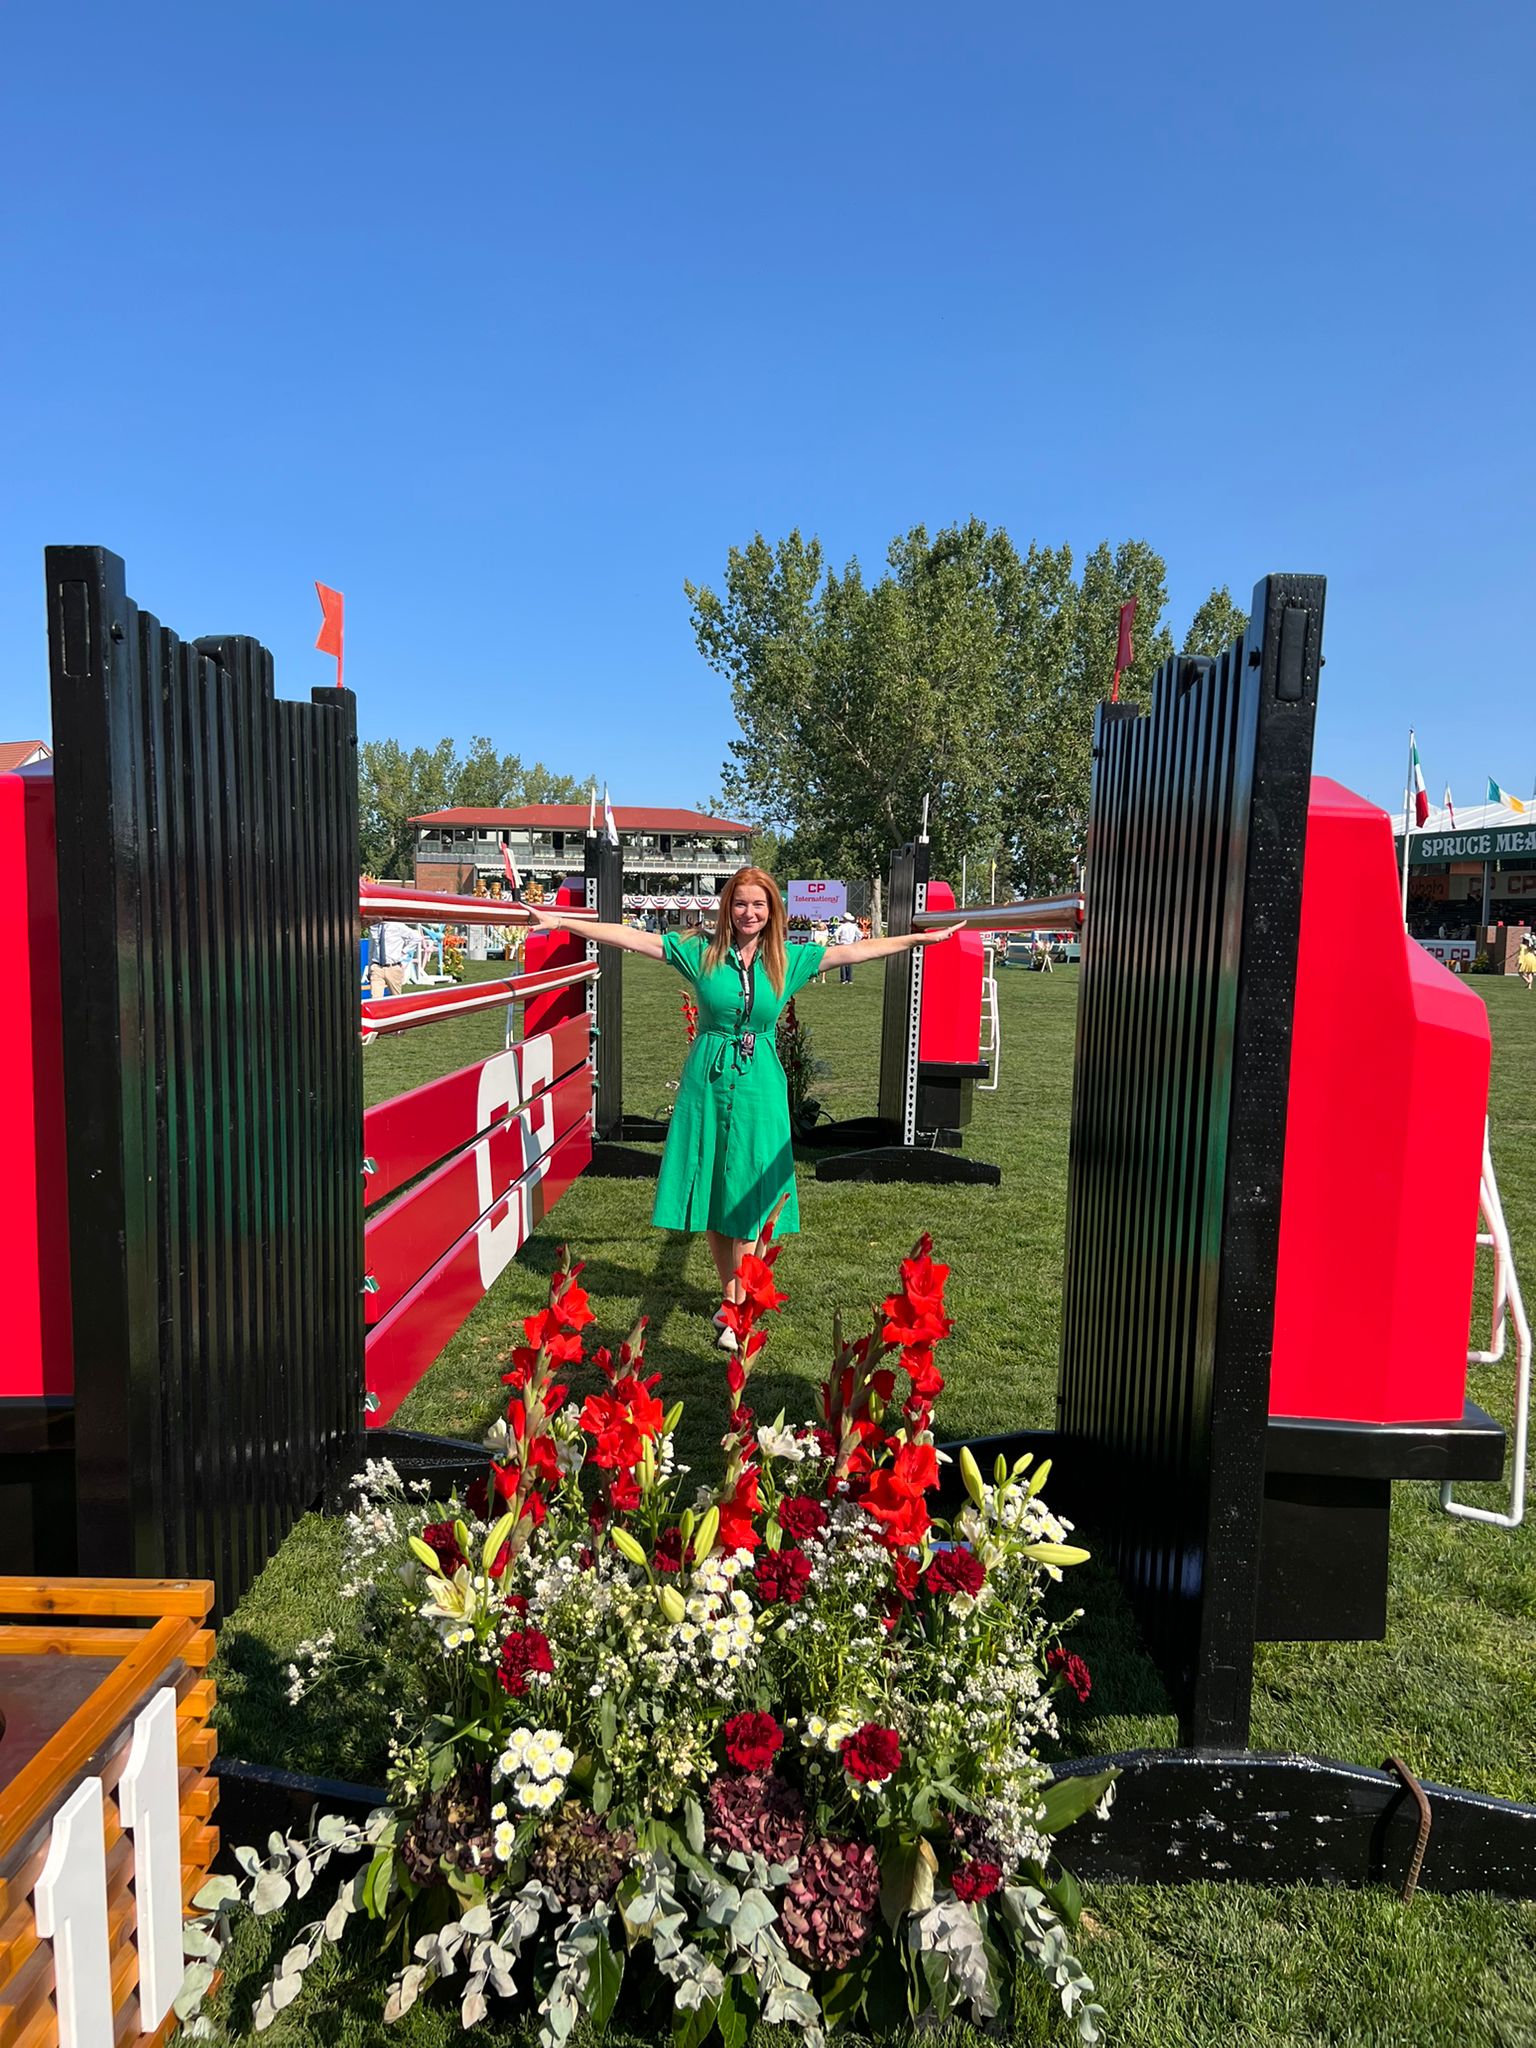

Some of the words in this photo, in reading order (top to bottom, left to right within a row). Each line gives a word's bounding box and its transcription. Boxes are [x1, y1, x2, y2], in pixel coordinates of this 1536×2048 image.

[1421, 835, 1491, 858] SPRUCE
[808, 883, 826, 893] CP
[1508, 875, 1536, 894] CP
[794, 895, 840, 904] International
[1451, 948, 1470, 960] CP
[477, 1033, 554, 1291] CP
